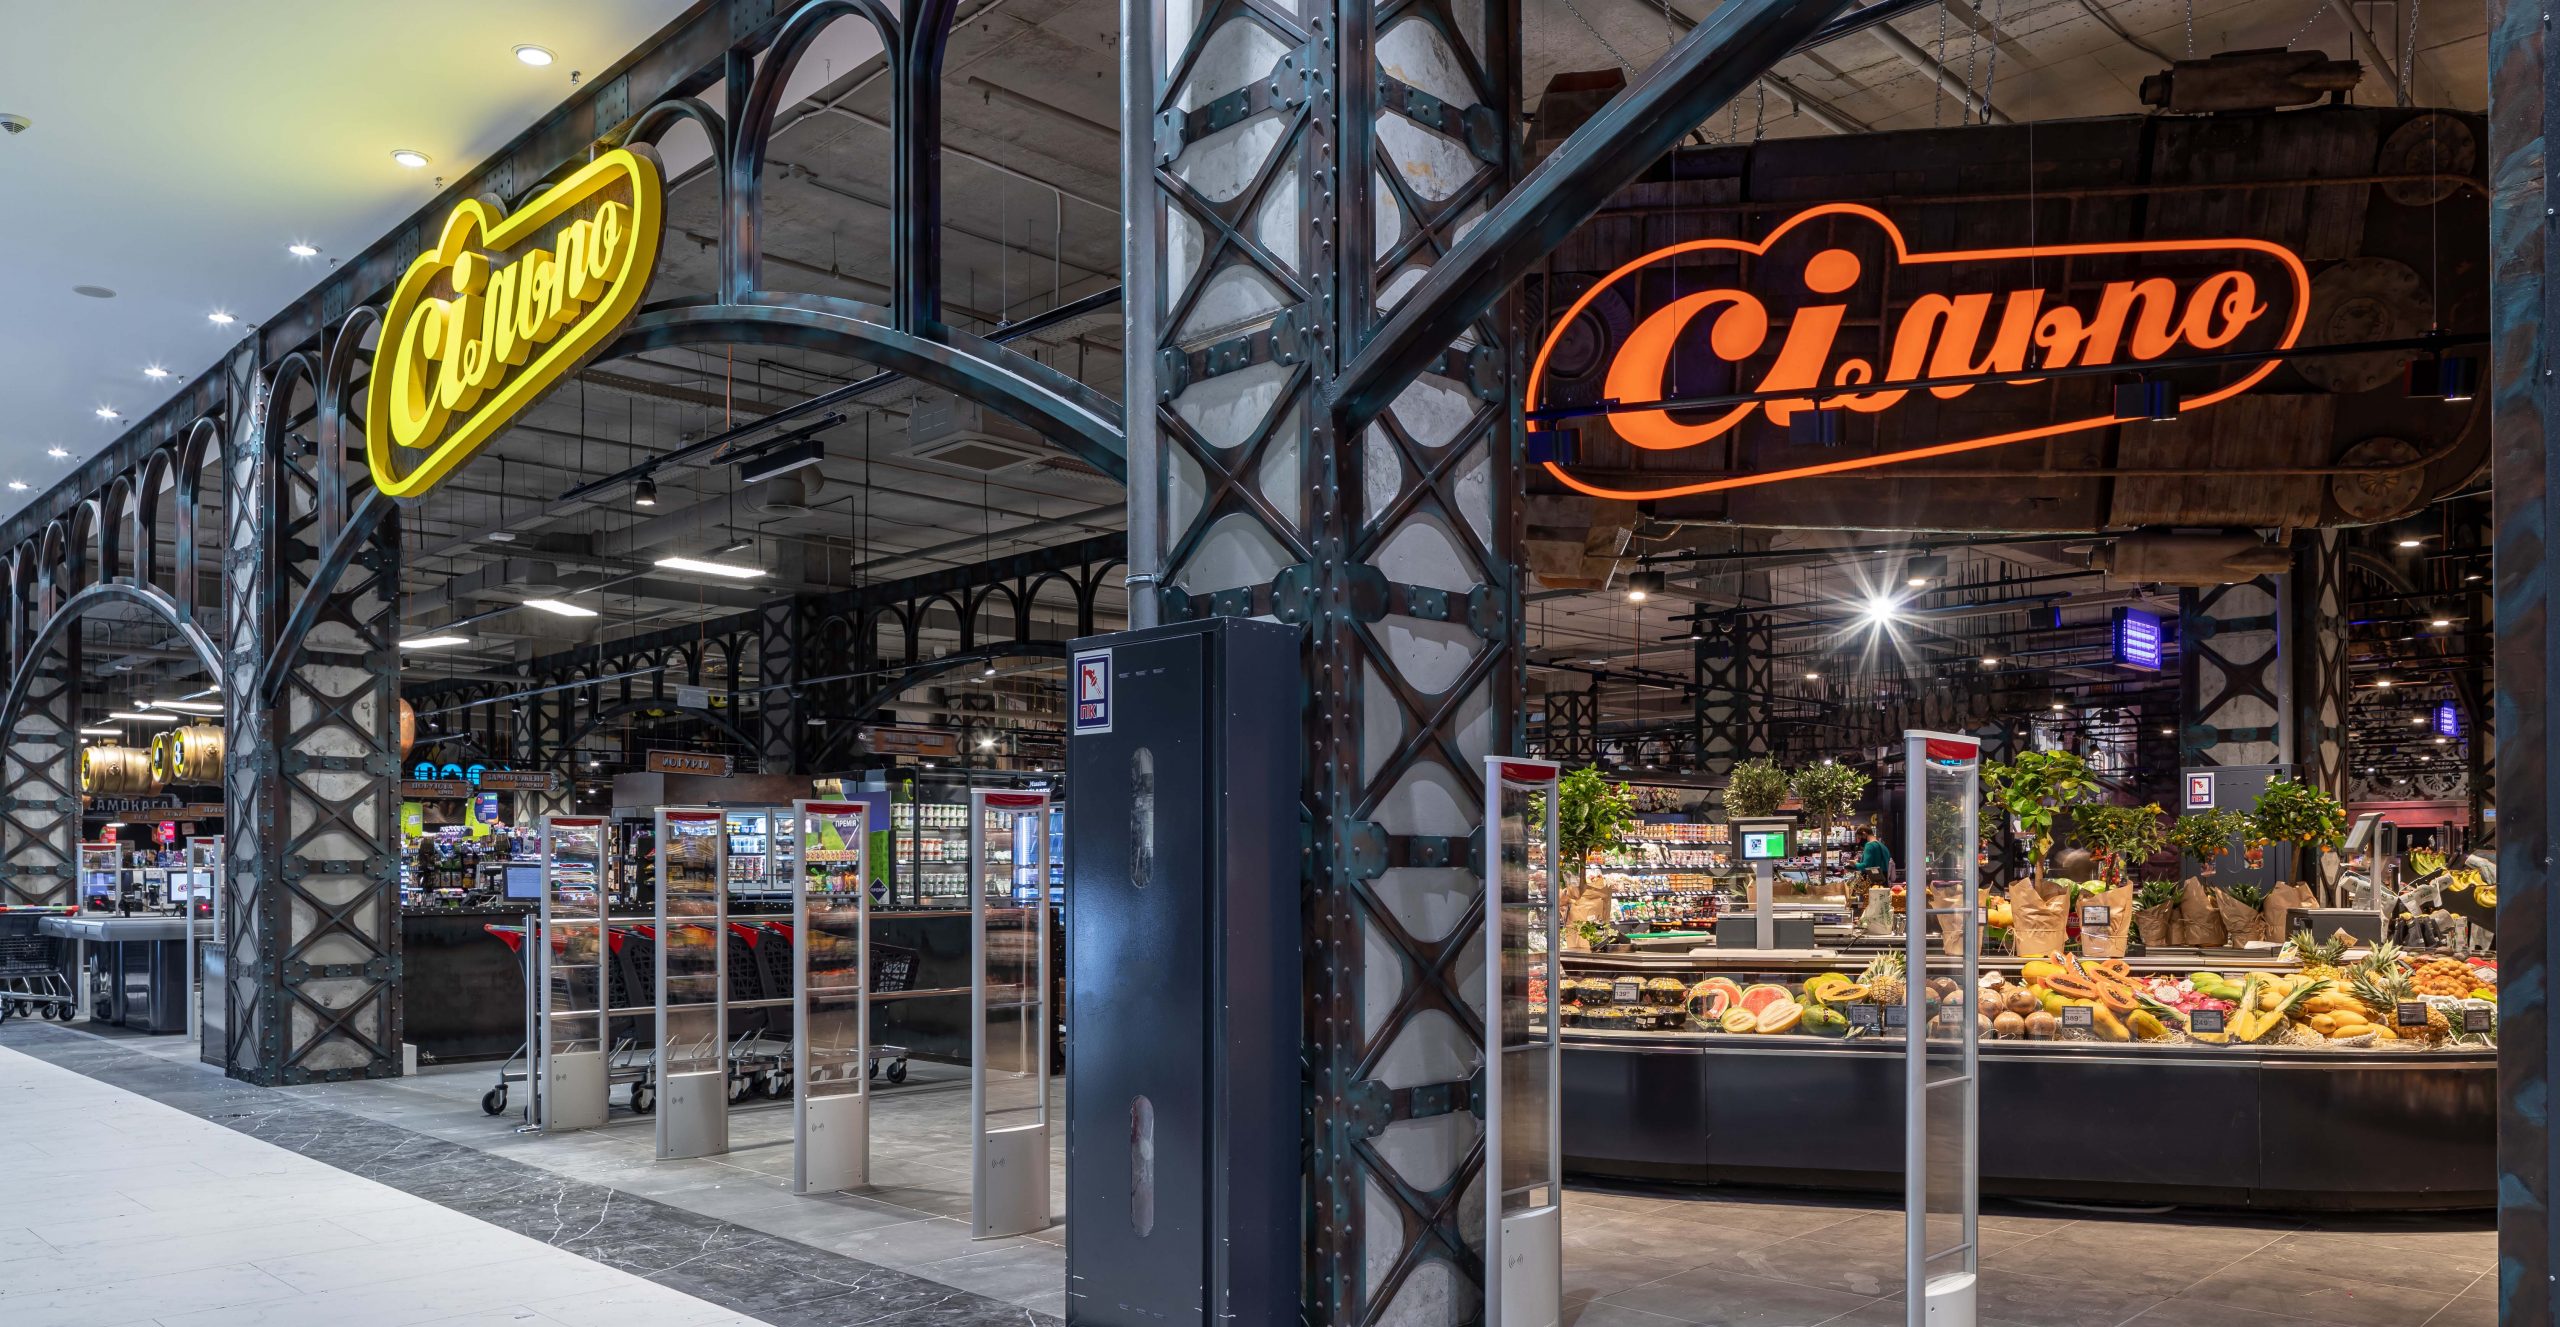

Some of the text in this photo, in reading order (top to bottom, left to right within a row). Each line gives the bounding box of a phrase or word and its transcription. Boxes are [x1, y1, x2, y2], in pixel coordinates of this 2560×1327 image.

[390, 200, 632, 447] Сільпо
[1603, 248, 2267, 450] Сільпо
[1080, 703, 1097, 719] ПК
[662, 755, 711, 770] ЙОГУРТИ
[835, 819, 857, 828] ПРЕМІЯ
